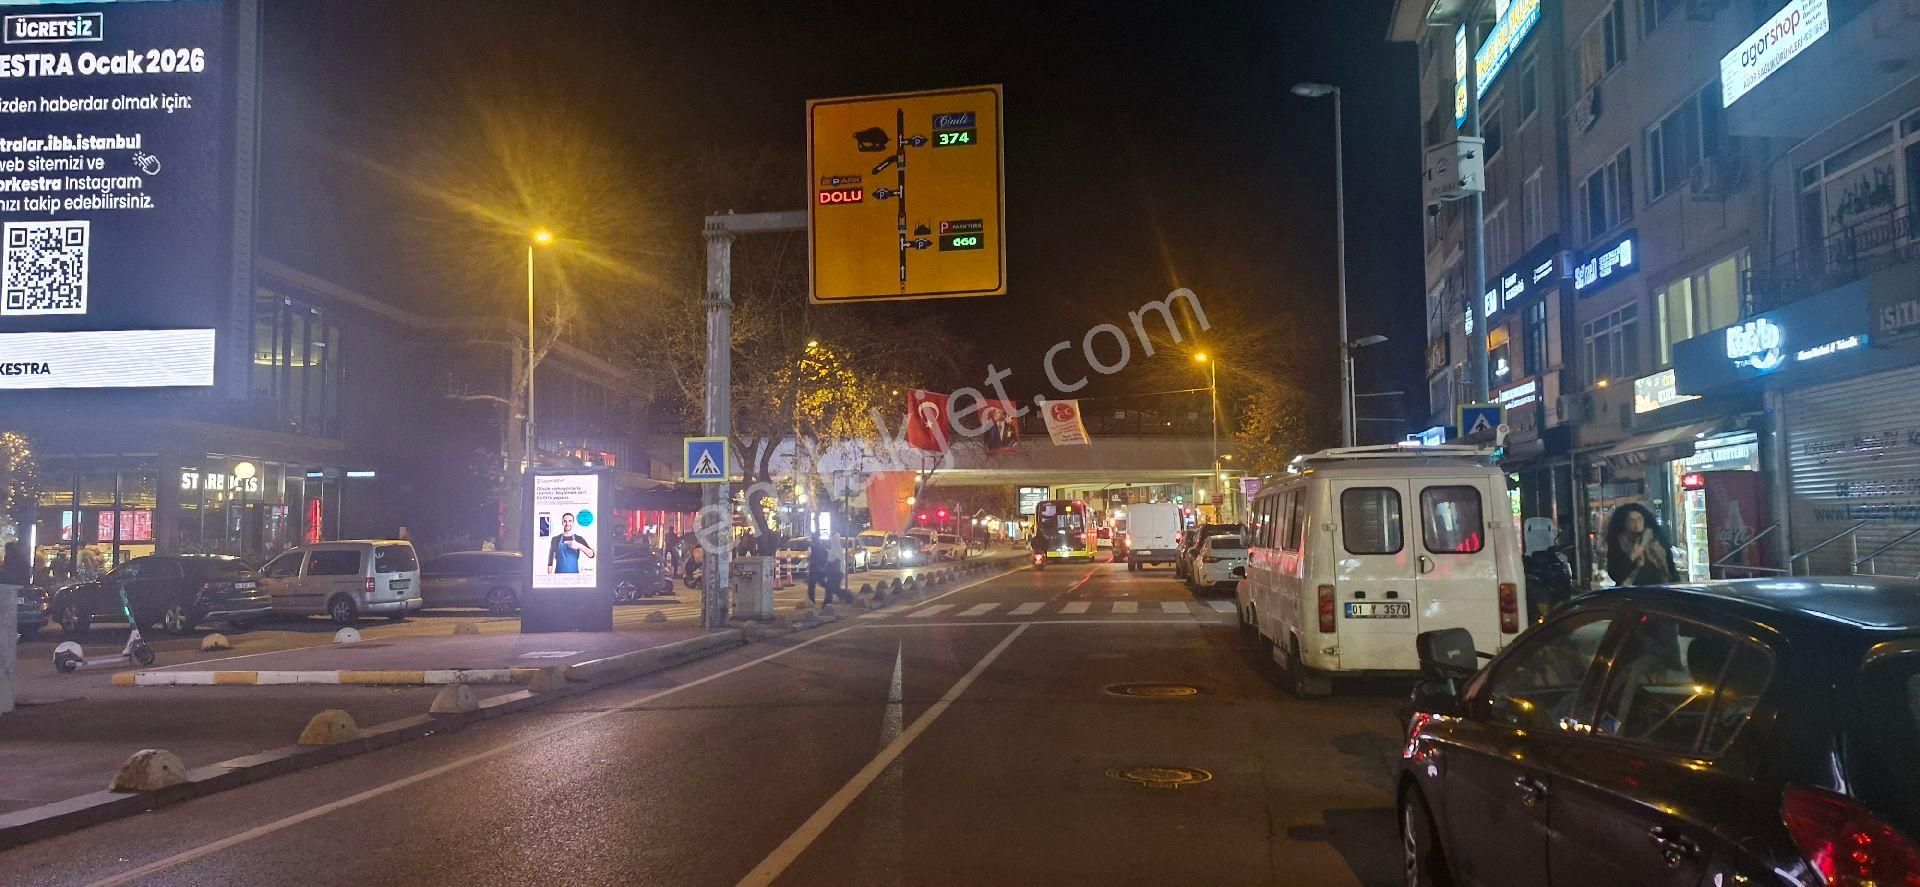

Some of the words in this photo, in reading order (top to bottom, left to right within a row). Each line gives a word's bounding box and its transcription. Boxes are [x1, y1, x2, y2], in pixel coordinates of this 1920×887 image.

[16, 16, 93, 38] ÜCRETSİZ
[1741, 9, 1800, 67] agorshop
[77, 50, 144, 76] Ocak
[146, 47, 205, 74] 2026
[40, 95, 109, 113] haberdar
[112, 94, 158, 111] olmak
[161, 93, 192, 113] için:
[939, 131, 970, 145] 374
[28, 155, 84, 172] sitemizi
[87, 158, 105, 170] ve
[65, 174, 142, 193] Instagram
[23, 193, 60, 215] takip
[64, 194, 155, 211] edebilirsiniz.
[819, 190, 862, 204] DOLU
[1352, 604, 1362, 615] 01
[1370, 604, 1377, 615] Y
[1384, 604, 1407, 615] 3570
